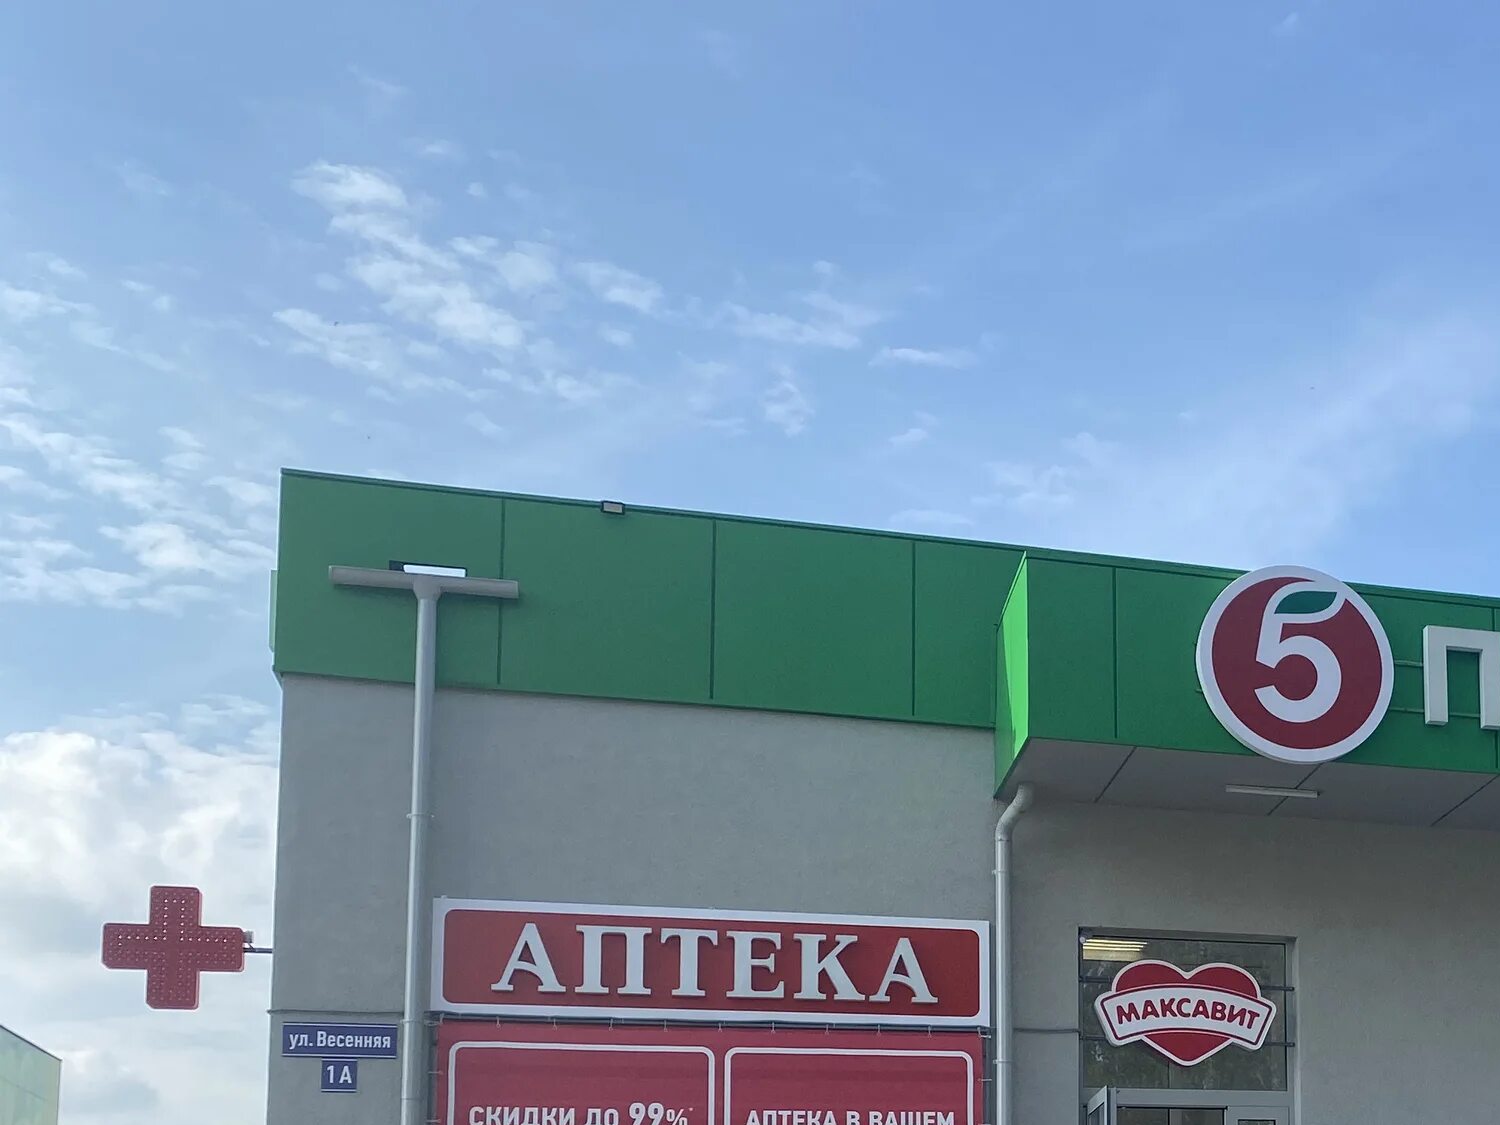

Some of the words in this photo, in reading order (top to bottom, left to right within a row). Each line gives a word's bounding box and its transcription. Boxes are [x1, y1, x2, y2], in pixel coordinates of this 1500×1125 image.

[1254, 580, 1347, 723] 5
[491, 922, 938, 1003] АПТЕКА
[289, 1033, 314, 1050] ул.
[316, 1031, 391, 1048] Весенняя
[1116, 998, 1260, 1029] МАКСАВИТ
